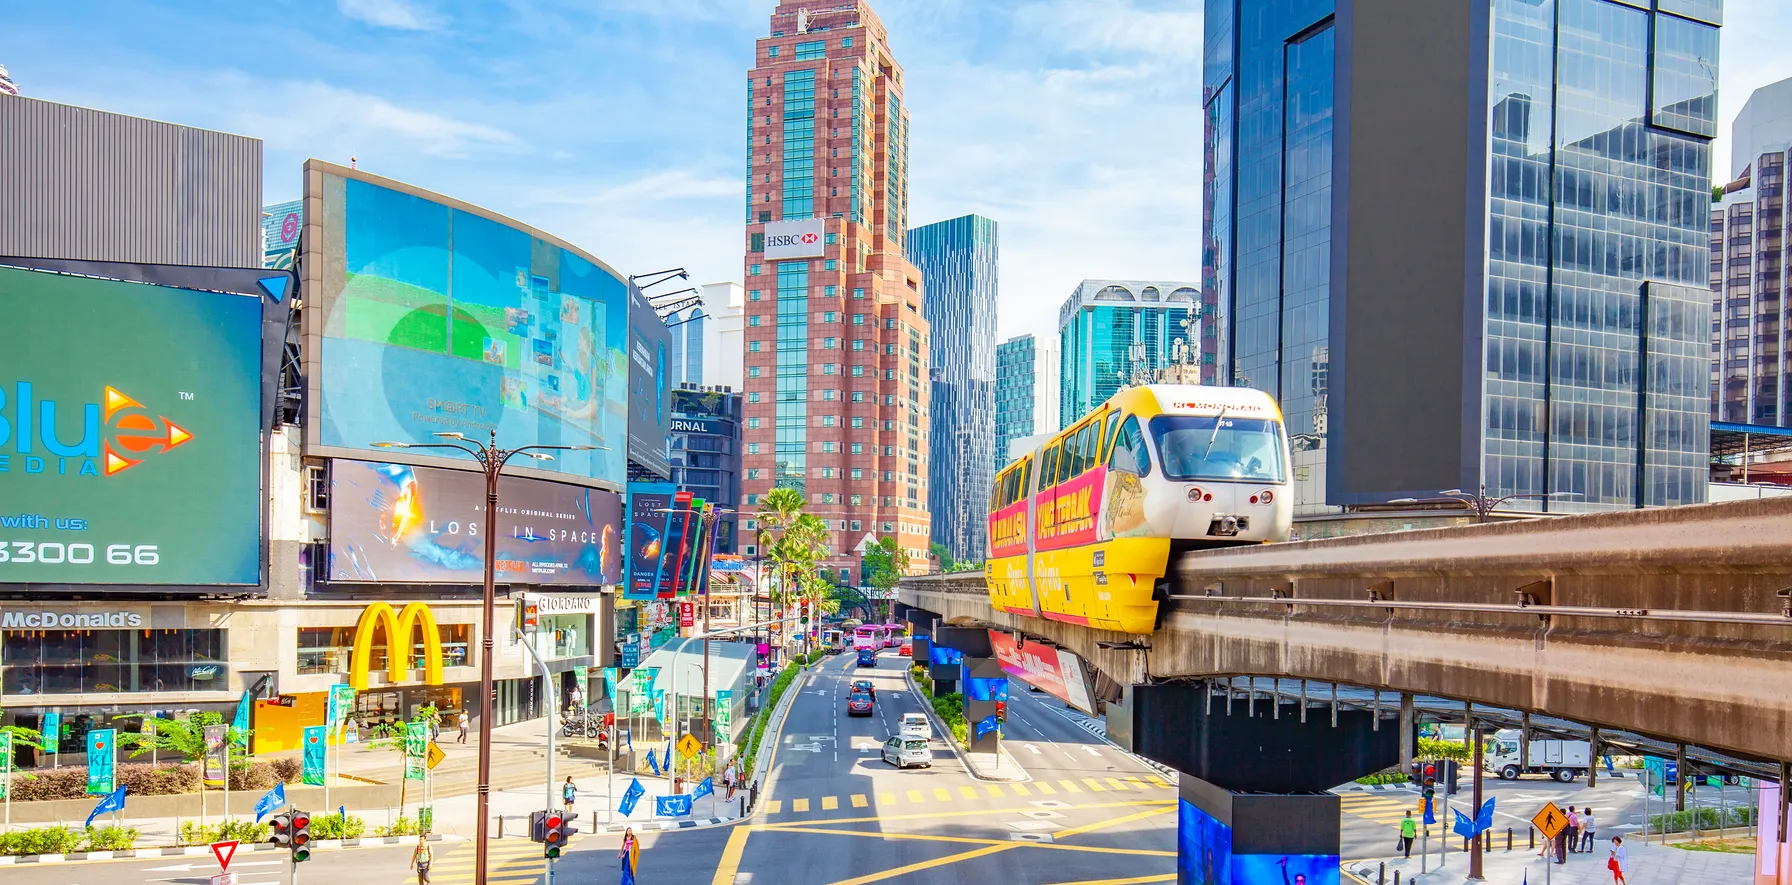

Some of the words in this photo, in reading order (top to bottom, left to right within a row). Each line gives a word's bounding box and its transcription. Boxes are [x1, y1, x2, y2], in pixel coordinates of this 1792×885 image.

[767, 234, 800, 247] HSBC
[473, 405, 487, 417] TV
[413, 412, 450, 425] Powered
[521, 509, 554, 518] ORIGINAL
[555, 512, 576, 521] SERIES
[430, 520, 478, 536] LOS
[514, 525, 534, 538] IN
[549, 528, 597, 545] SPACE
[106, 544, 160, 566] 66
[539, 596, 590, 611] GIORDANO
[1, 611, 142, 628] McDonald's
[90, 754, 110, 767] KL
